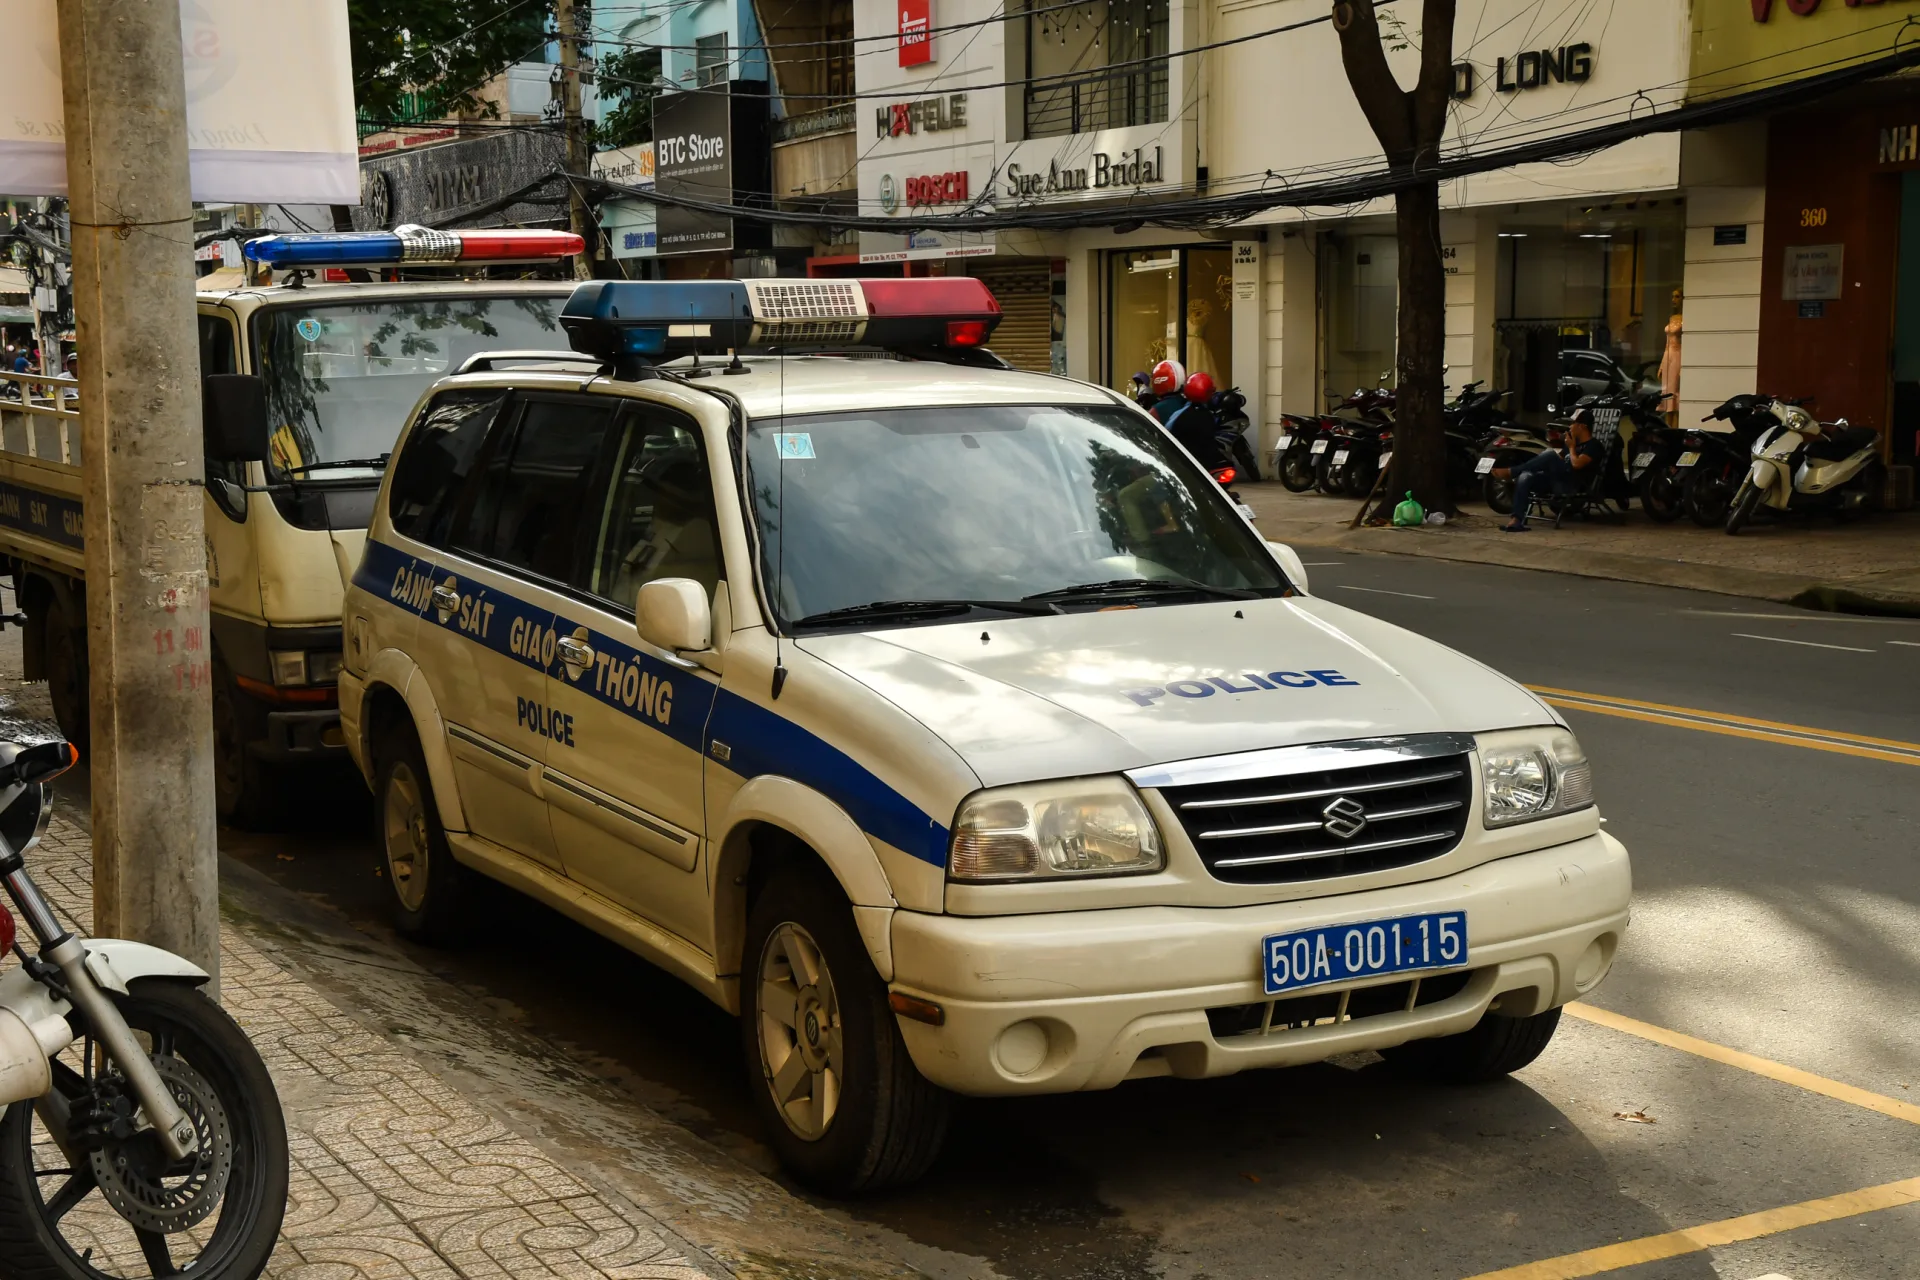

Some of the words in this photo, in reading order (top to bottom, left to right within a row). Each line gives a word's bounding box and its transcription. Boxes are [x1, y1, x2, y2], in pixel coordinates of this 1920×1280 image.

[1496, 42, 1591, 93] LONG
[659, 136, 686, 167] BTC
[689, 134, 724, 162] Store
[1007, 162, 1042, 197] Sue
[1044, 158, 1089, 192] Ann
[1093, 145, 1164, 189] Bridal
[906, 171, 969, 207] BOSCH
[1800, 207, 1828, 227] 360
[1238, 246, 1252, 256] 366
[390, 559, 435, 612] CẢNH
[459, 590, 495, 638] SÁT
[510, 616, 557, 668] GIAO
[595, 651, 673, 725] THÔNG
[1120, 669, 1362, 708] POLICE
[517, 695, 575, 748] POLICE
[1271, 916, 1460, 985] 50A-001.15
